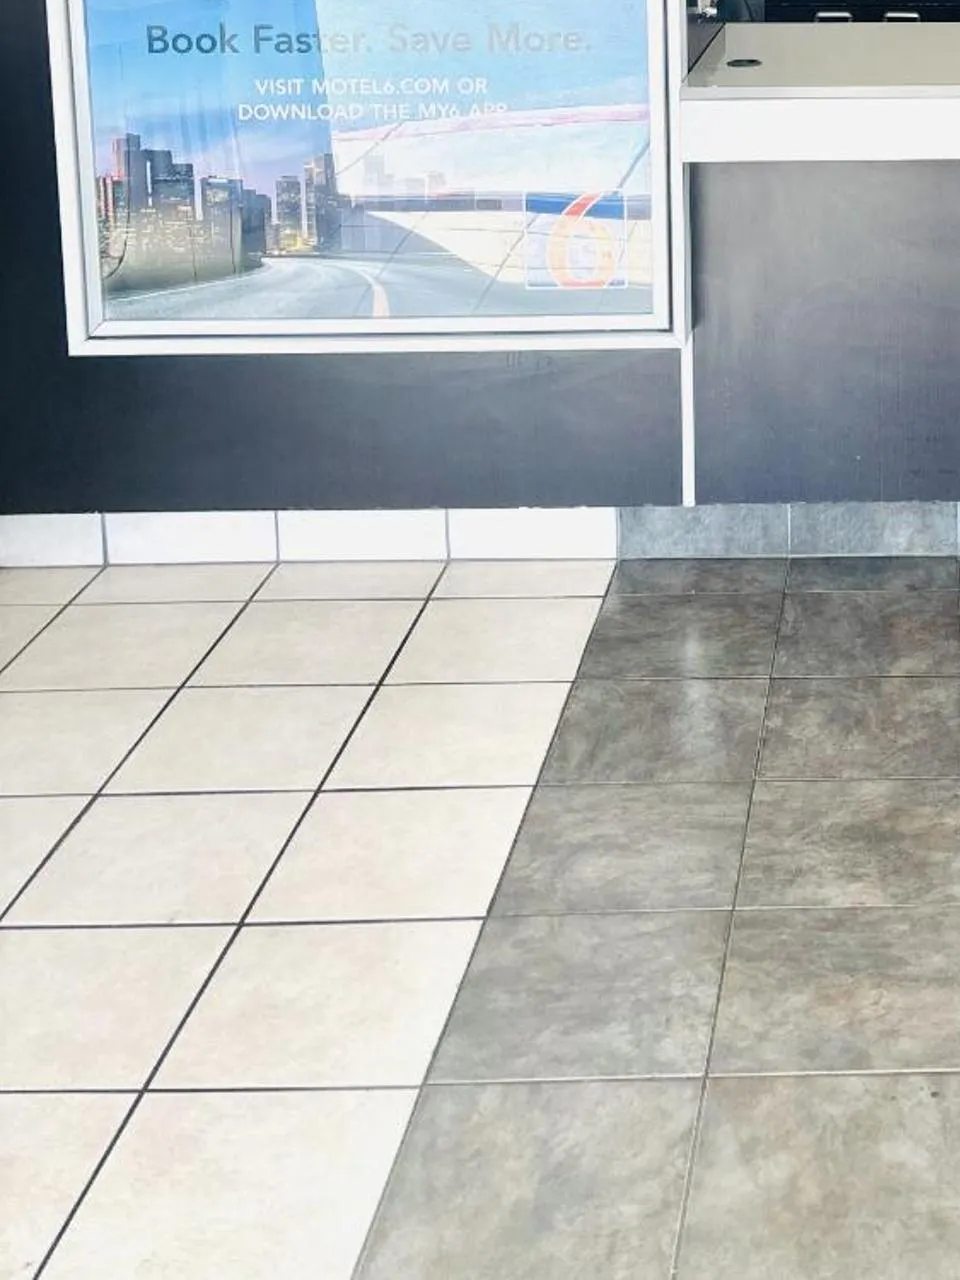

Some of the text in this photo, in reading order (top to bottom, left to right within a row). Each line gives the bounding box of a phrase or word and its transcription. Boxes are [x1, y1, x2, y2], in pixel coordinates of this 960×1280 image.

[146, 22, 239, 54] Book
[253, 24, 372, 54] Faster.
[389, 23, 472, 53] Save
[255, 77, 488, 96] VISIT MOTEL6.COM OR
[238, 103, 363, 121] DOWNLOAD
[372, 103, 410, 120] THE
[418, 102, 459, 119] MY6
